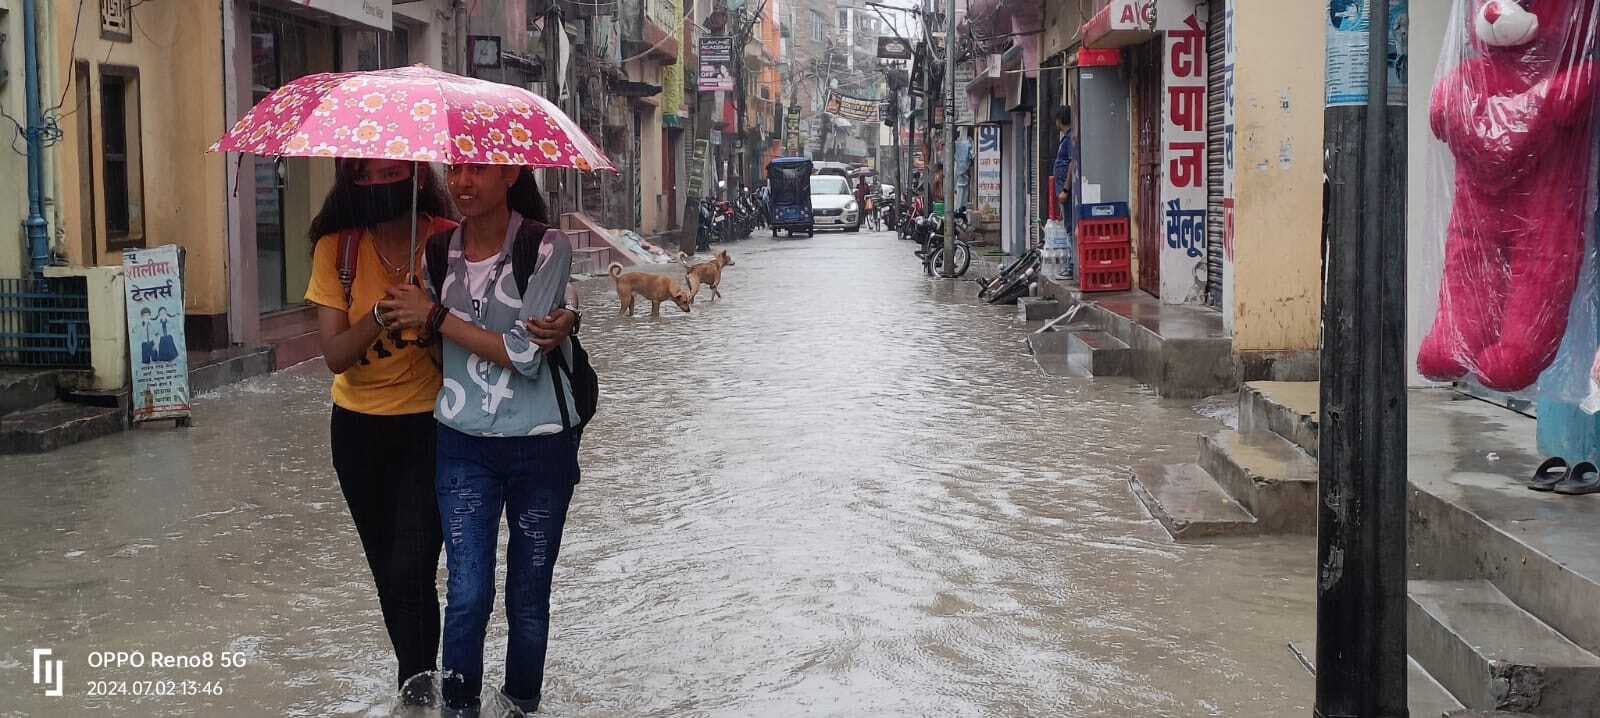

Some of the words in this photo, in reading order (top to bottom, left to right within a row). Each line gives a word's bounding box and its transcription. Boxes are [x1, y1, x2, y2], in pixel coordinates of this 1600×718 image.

[1167, 15, 1206, 188] टोपाज
[1166, 198, 1206, 258] सैलून
[130, 279, 173, 302] टेलर्स
